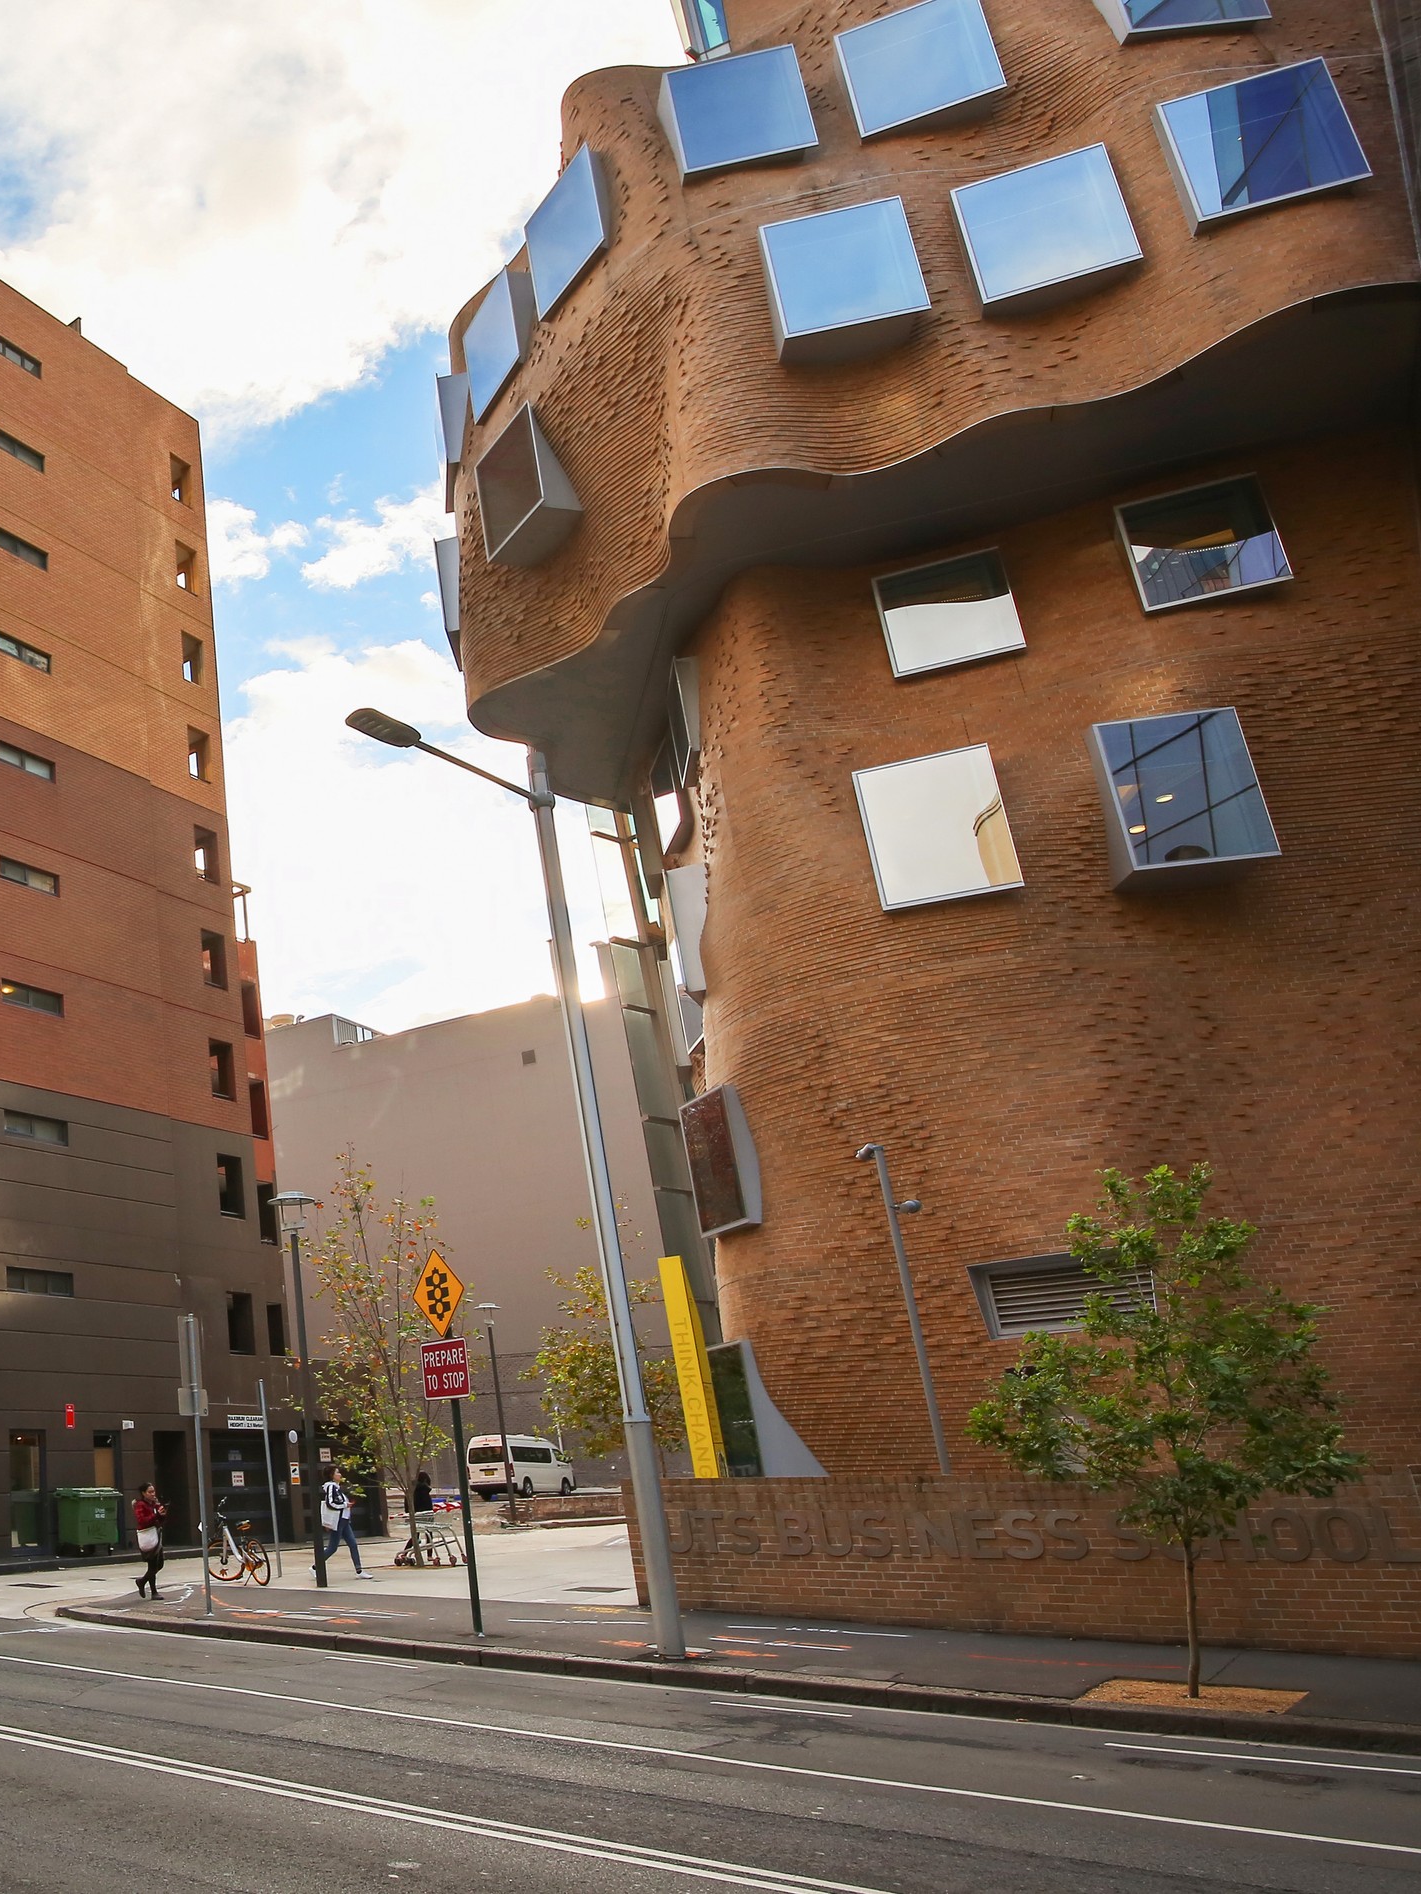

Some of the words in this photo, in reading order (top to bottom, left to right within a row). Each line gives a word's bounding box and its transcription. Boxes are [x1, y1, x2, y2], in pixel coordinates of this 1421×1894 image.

[423, 1347, 465, 1369] PREPARE
[426, 1374, 438, 1391] TO
[442, 1371, 465, 1390] STOP
[673, 1317, 714, 1478] THINK.CHANG
[668, 1509, 761, 1555] UTS
[778, 1509, 1089, 1561] BUSINESS
